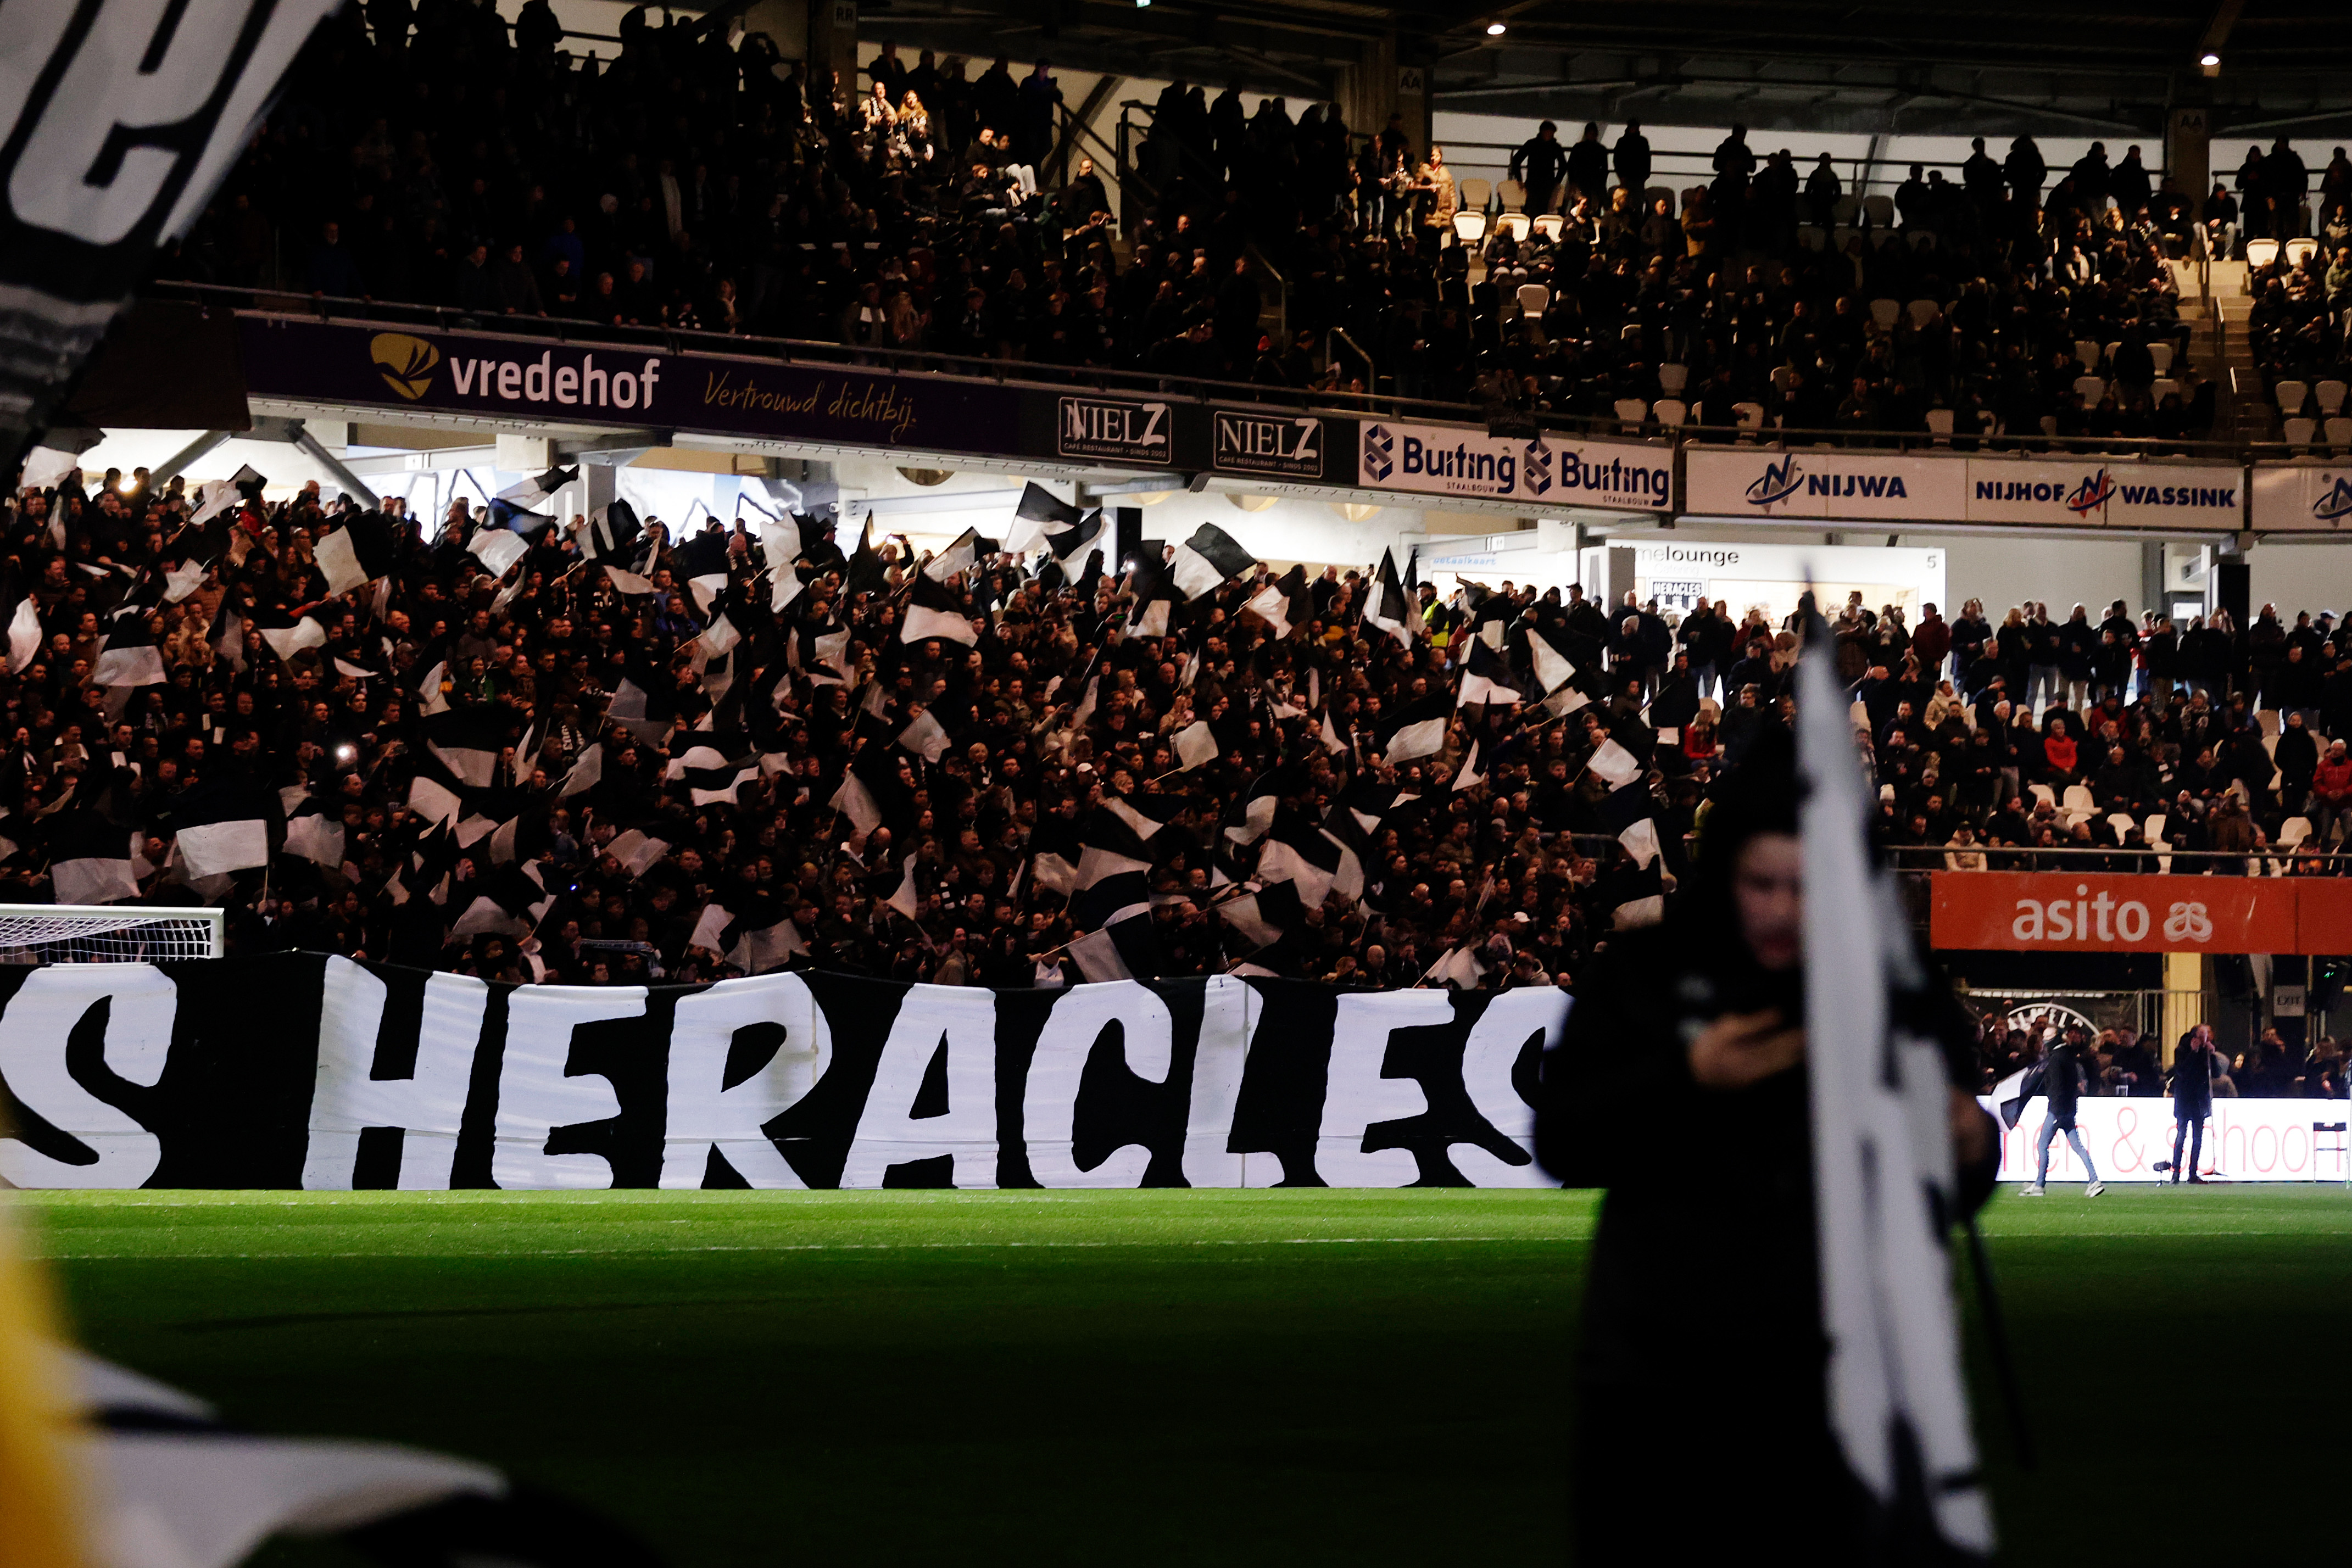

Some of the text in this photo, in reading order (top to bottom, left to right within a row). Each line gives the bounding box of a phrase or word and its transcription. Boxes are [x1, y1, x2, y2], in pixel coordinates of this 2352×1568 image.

[450, 350, 660, 410] vredehof
[705, 371, 825, 414] Vertrouwd
[1064, 400, 1166, 447] NIELZ
[1082, 444, 1124, 454] RESTAURANT
[1219, 417, 1318, 460] NIELZ
[1236, 458, 1277, 467] RESTAURANT
[1403, 435, 1515, 493] Buiting
[1446, 482, 1495, 493] STAALBOUW
[1561, 451, 1669, 506] Buiting
[1809, 475, 1908, 498] NIJWA
[1602, 495, 1649, 506] STAALBOUW
[1976, 481, 2065, 501] NIJHOF
[2121, 486, 2236, 507] WASSINK
[1619, 545, 1740, 567] melounge
[1927, 555, 1937, 568] 5
[1653, 583, 1701, 596] HERACLES
[2013, 884, 2150, 942] asito
[2277, 995, 2301, 1006] EXIT
[302, 954, 1576, 1189] HERACLES
[2111, 1106, 2148, 1173] &
